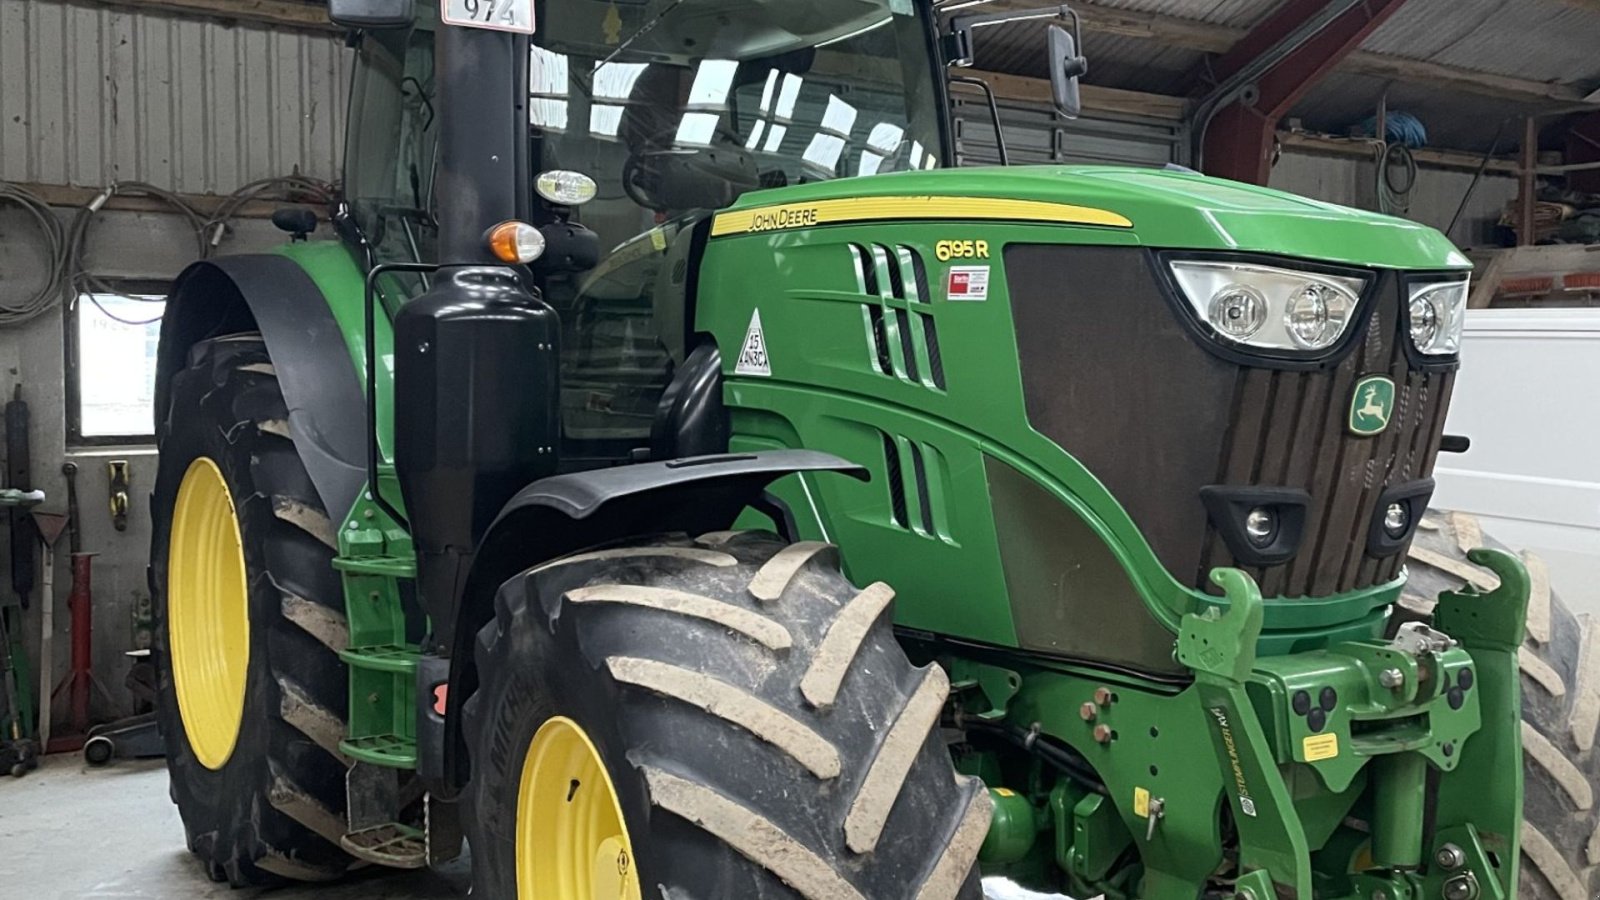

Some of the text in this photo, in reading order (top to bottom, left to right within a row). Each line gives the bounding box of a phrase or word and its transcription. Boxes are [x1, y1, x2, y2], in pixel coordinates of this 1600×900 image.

[749, 208, 818, 230] JOHN DEERE
[749, 334, 759, 349] 15
